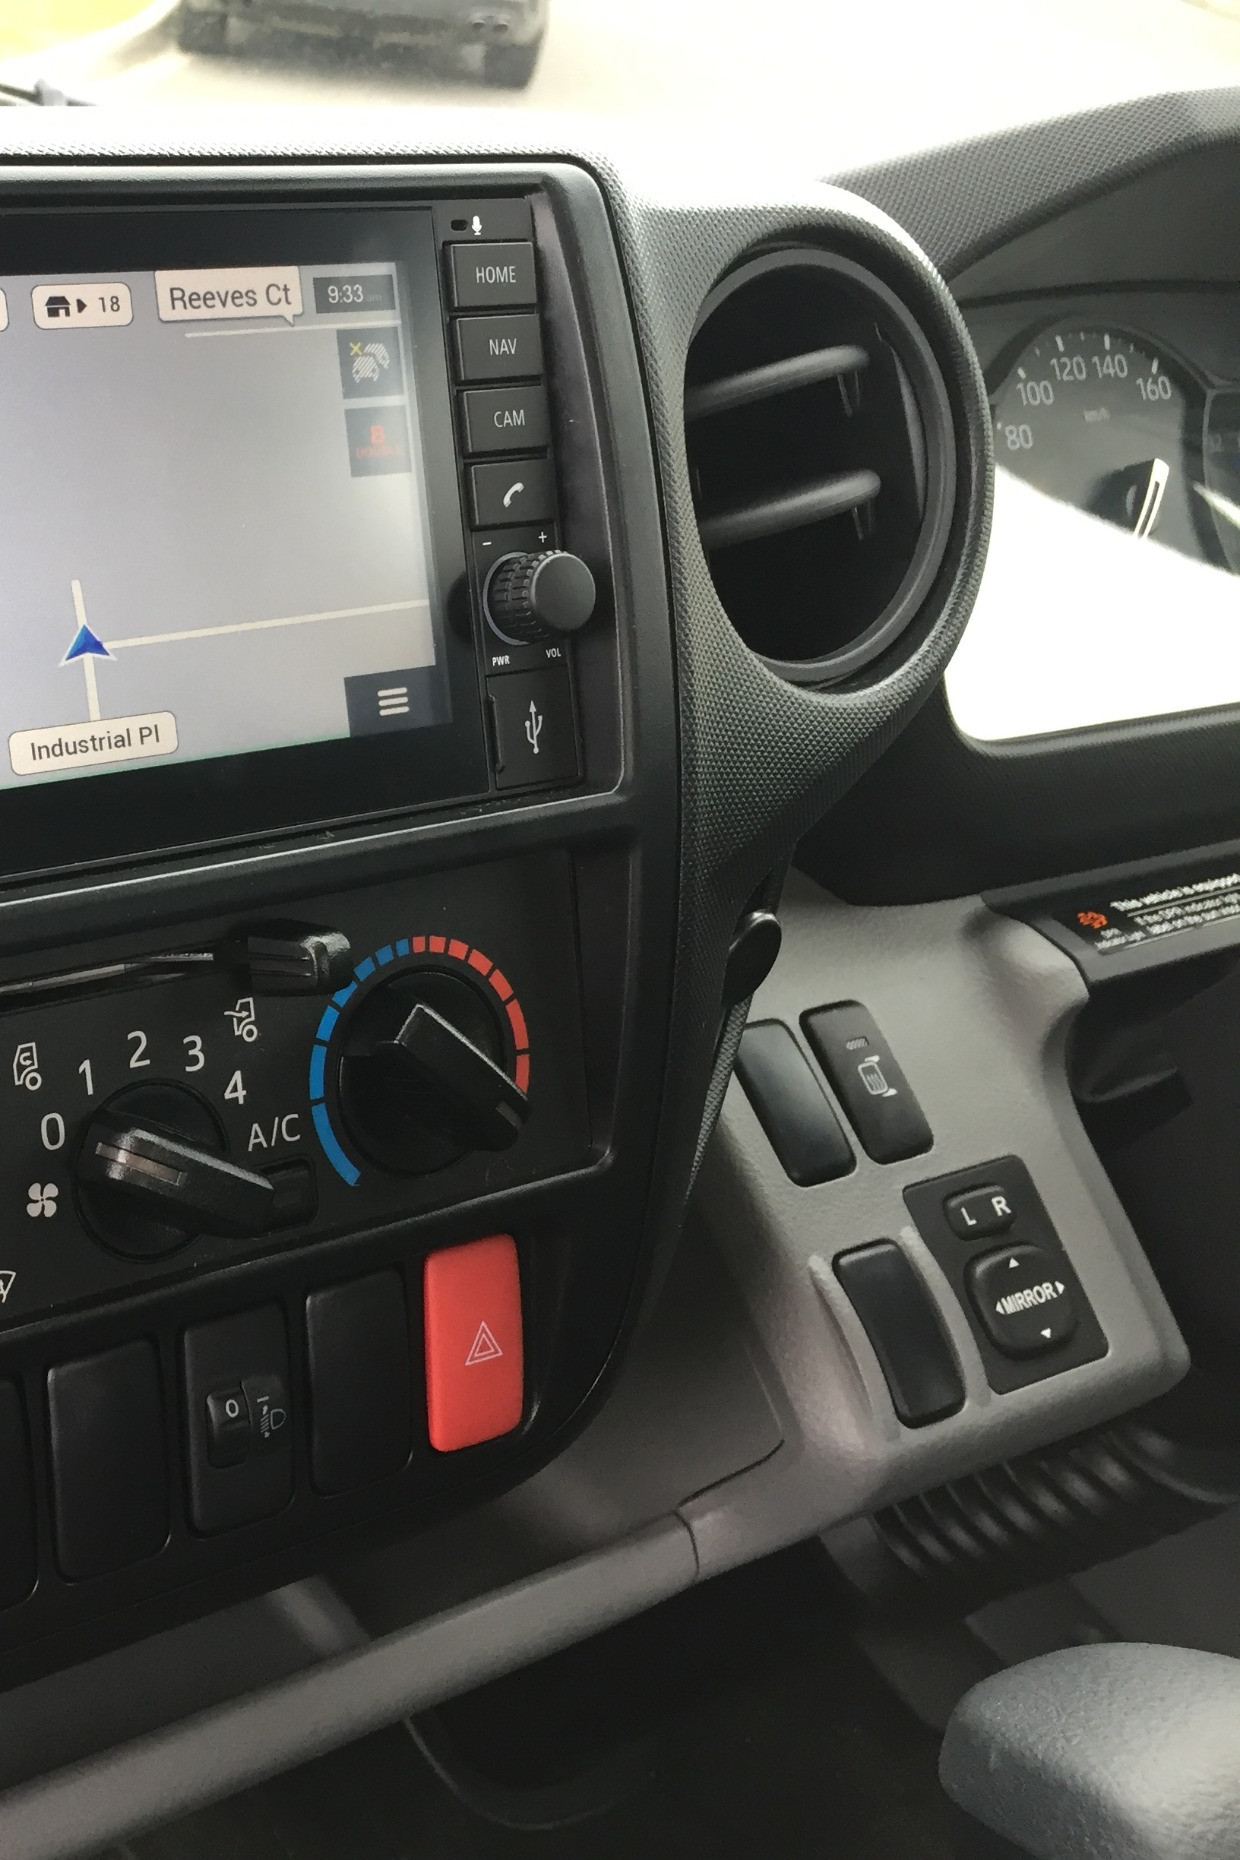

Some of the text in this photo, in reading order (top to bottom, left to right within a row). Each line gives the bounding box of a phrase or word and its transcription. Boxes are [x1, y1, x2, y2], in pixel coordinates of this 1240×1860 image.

[475, 265, 517, 284] HOME
[98, 295, 121, 313] 18
[169, 283, 292, 311] Reeves Ct
[327, 284, 364, 304] 9:33
[489, 337, 517, 356] NAV
[1049, 355, 1087, 382] 120
[1091, 353, 1129, 380] 140
[1016, 380, 1055, 407] 100
[1135, 375, 1172, 402] 160
[493, 409, 526, 428] CAM
[1004, 423, 1034, 451] 80
[491, 654, 511, 667] PWR
[545, 647, 562, 659] VOL
[30, 723, 160, 761] Industrial Pl
[127, 1030, 151, 1069] 2
[182, 1035, 205, 1072] 3
[78, 1059, 94, 1096] 1
[223, 1069, 247, 1105] 4
[40, 1112, 66, 1151] 0
[247, 1113, 301, 1152] A/C
[960, 1195, 1012, 1226] L R
[1001, 1282, 1059, 1315] MIRROR
